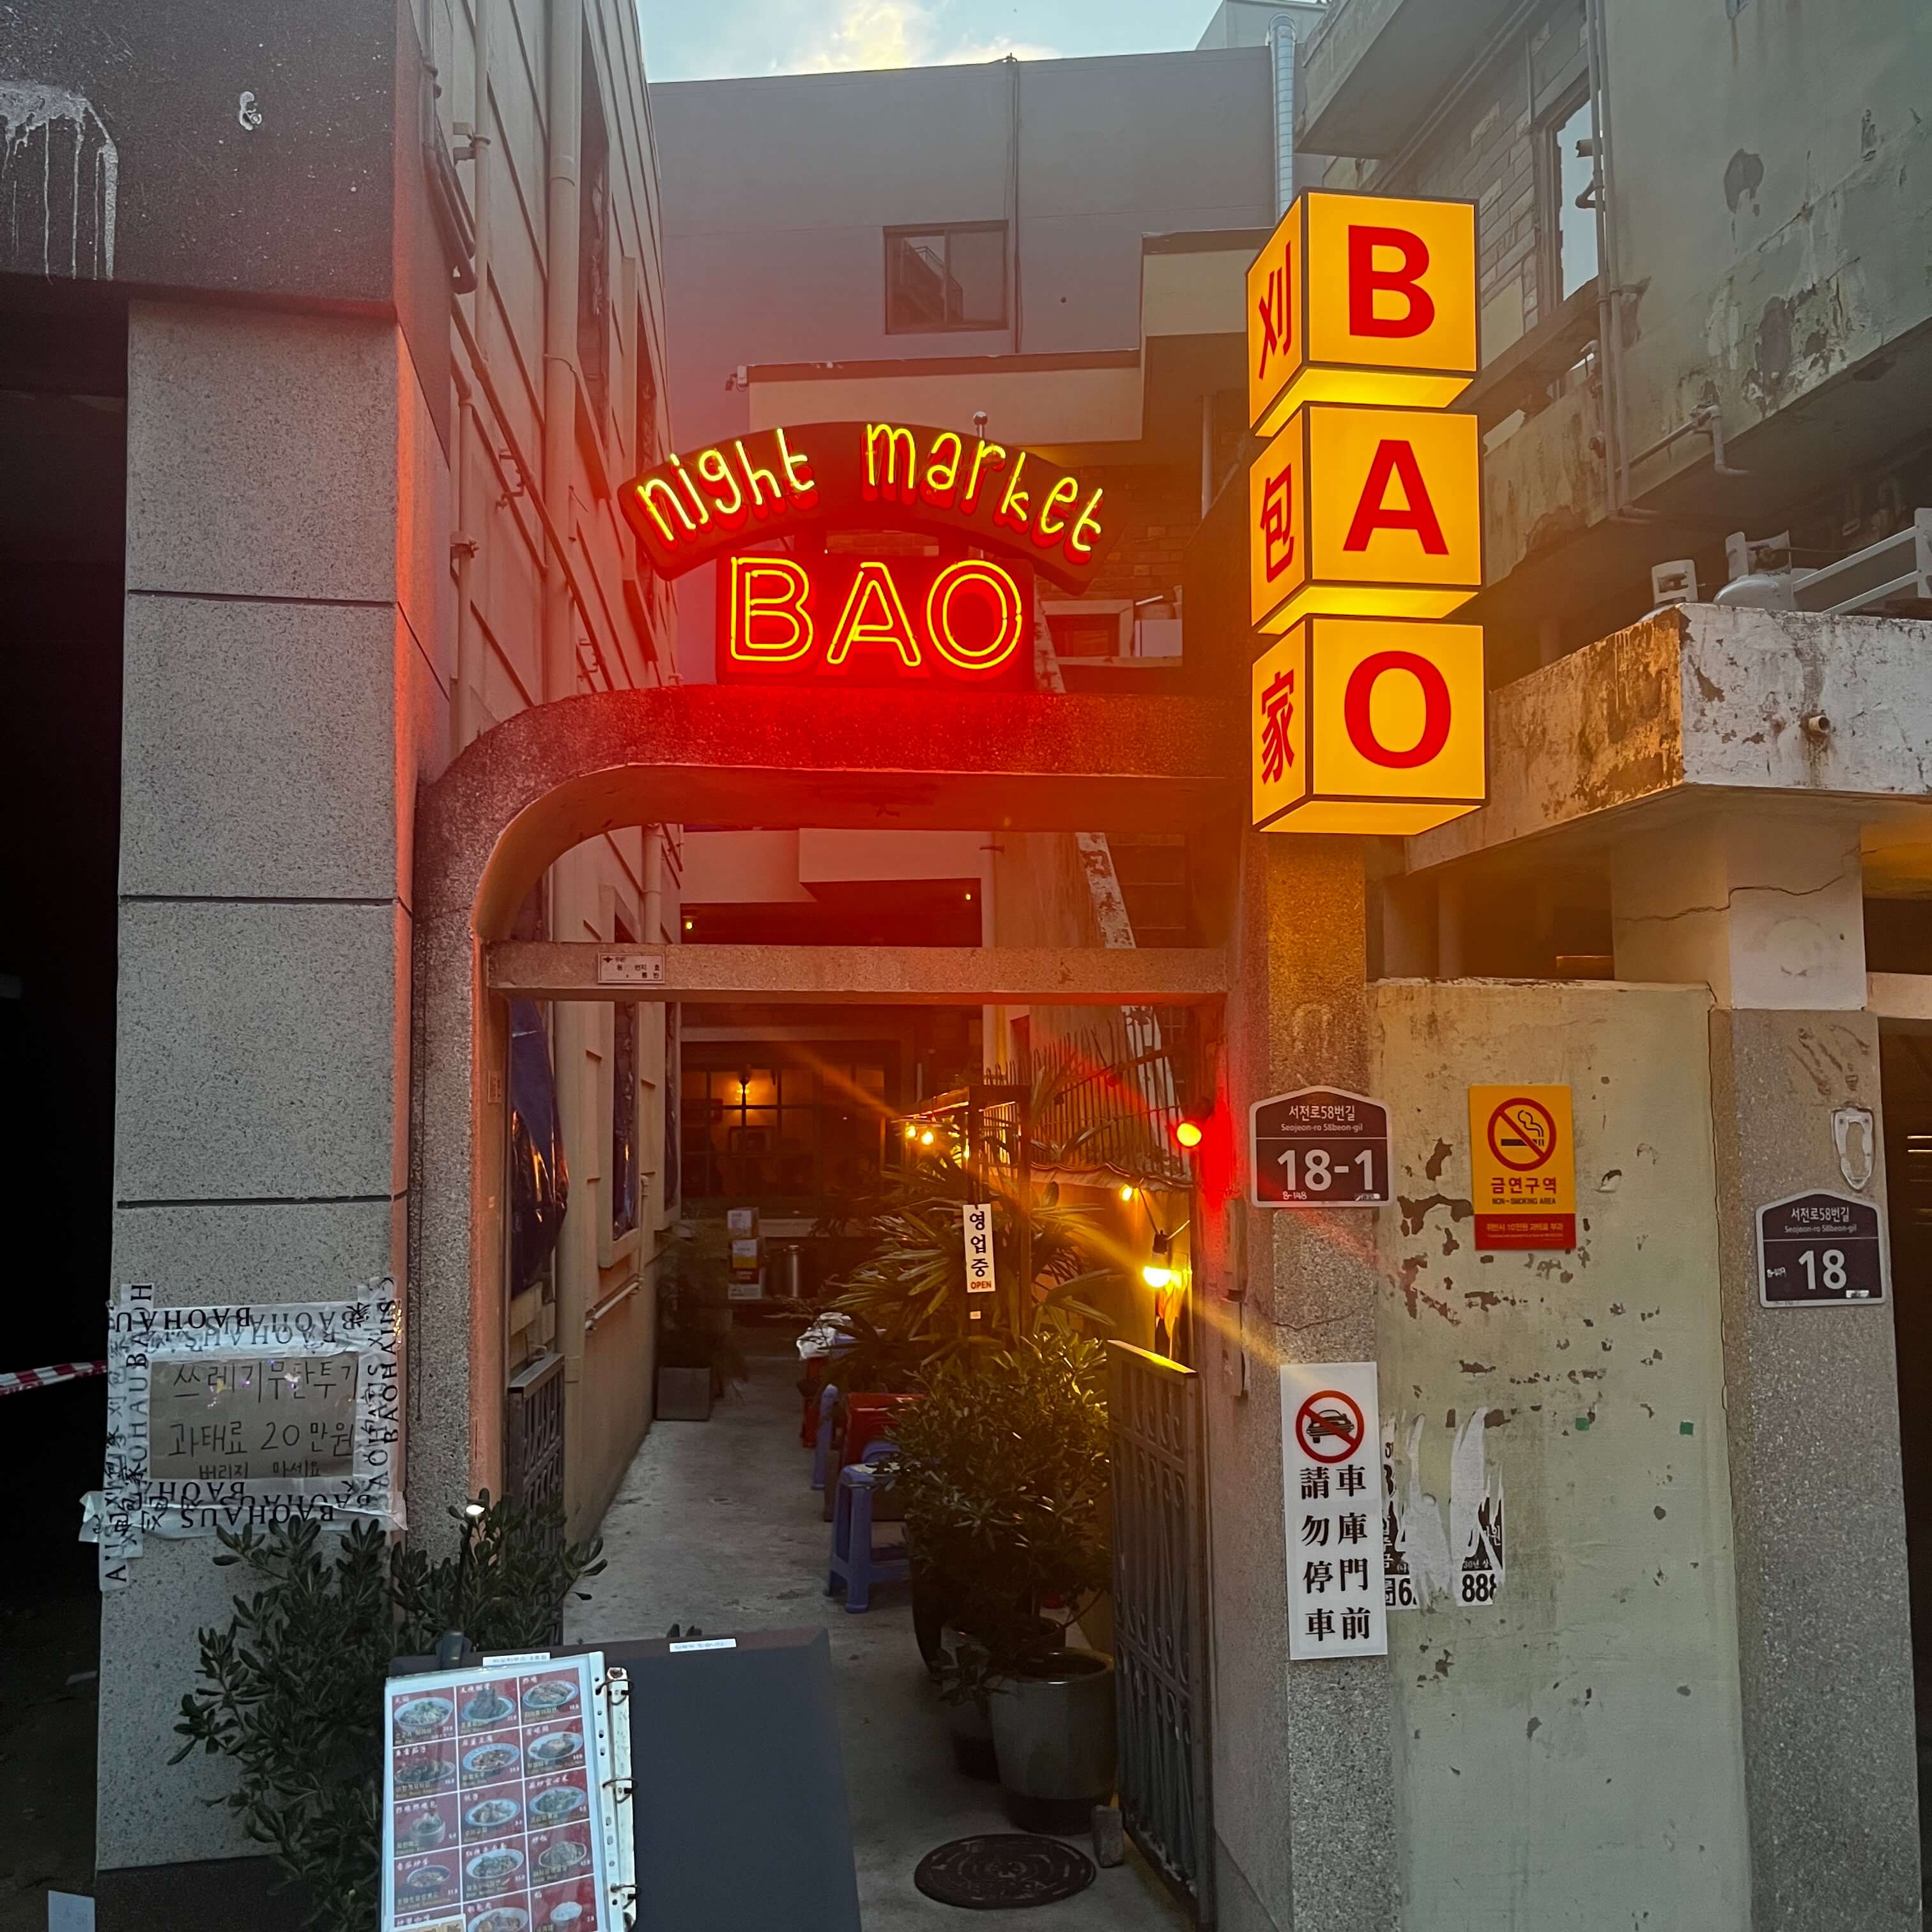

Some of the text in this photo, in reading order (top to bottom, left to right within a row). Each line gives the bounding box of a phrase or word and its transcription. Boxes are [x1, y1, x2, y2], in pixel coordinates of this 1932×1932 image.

[637, 424, 1104, 552] night market
[1342, 224, 1452, 768] BAO
[1258, 240, 1294, 785] 刈包家
[730, 556, 1022, 670] BAO
[1281, 1123, 1363, 1133] Seojeon-ro 58beon-gil
[1289, 1105, 1355, 1121] 서전로58번길
[1277, 1149, 1373, 1192] 18-1
[1491, 1177, 1556, 1195] 금연구역
[1791, 1206, 1850, 1223] 서전로58번길
[969, 1211, 988, 1278] 영업중
[970, 1280, 992, 1290] OPEN
[1798, 1249, 1847, 1290] 18
[169, 1421, 248, 1457] 과태료
[180, 1503, 334, 1529] BAOHAUS
[1299, 1466, 1335, 1642] 請勿停車
[1335, 1464, 1371, 1641] 車庫門前
